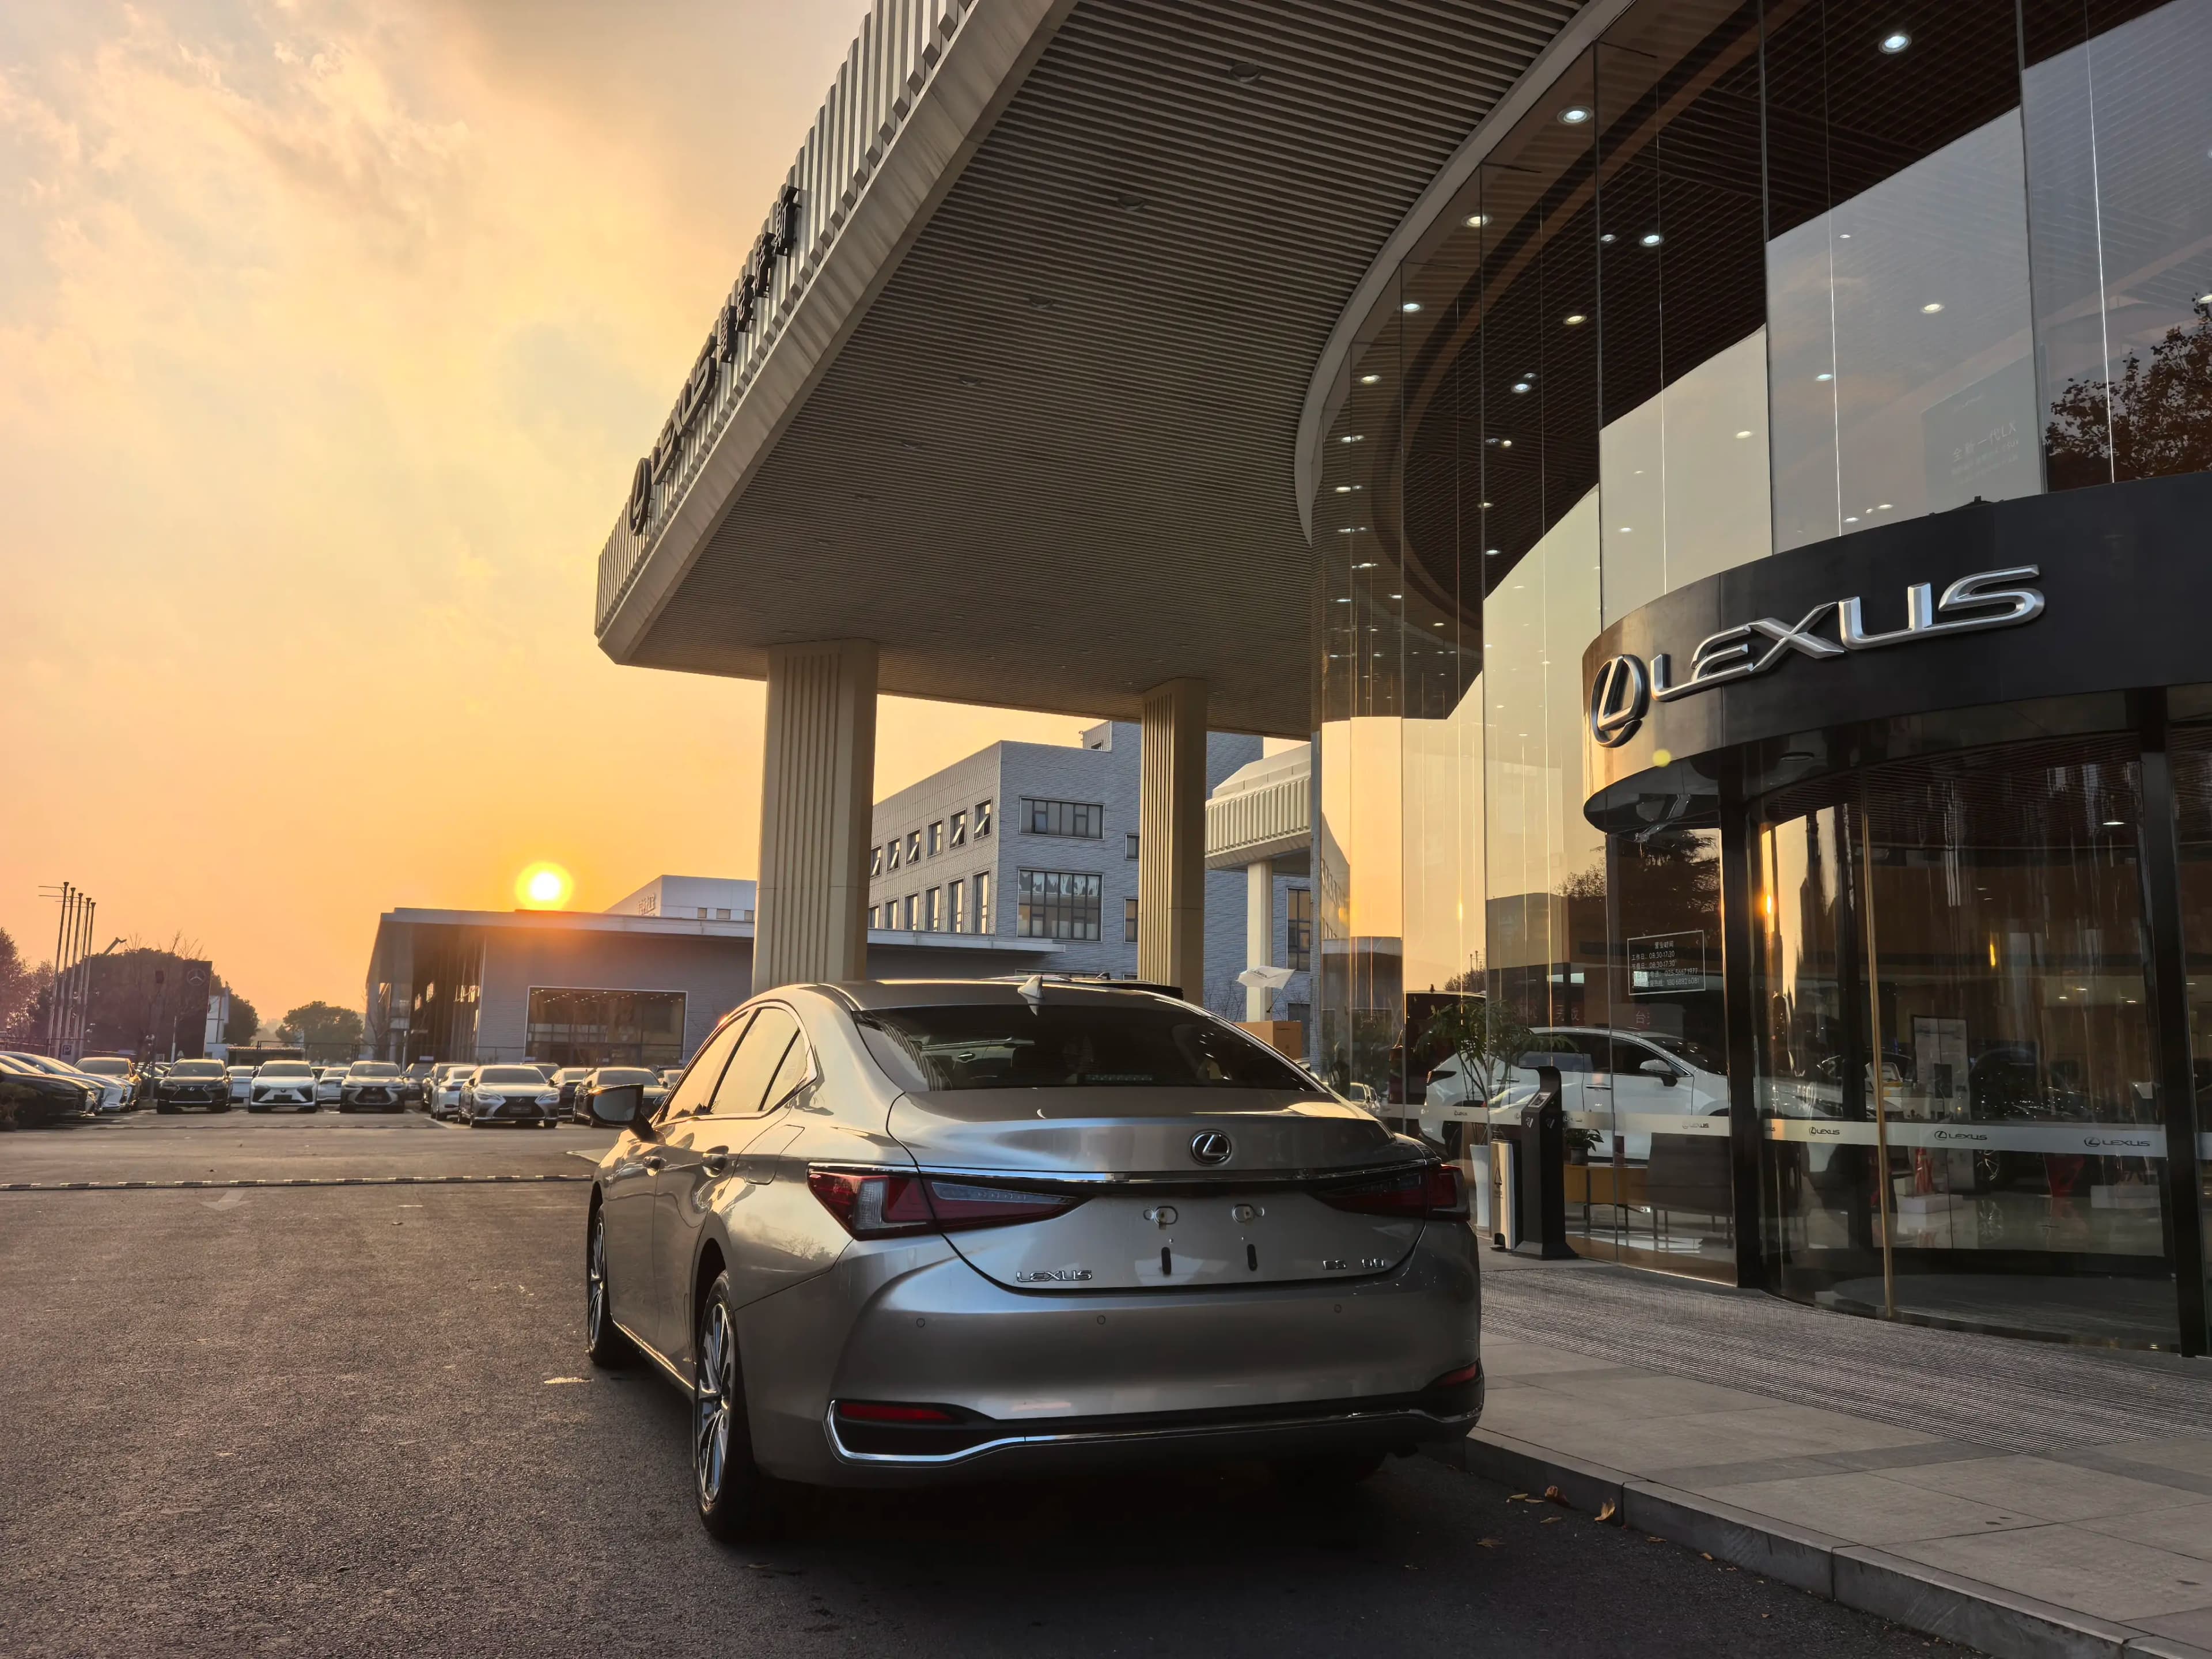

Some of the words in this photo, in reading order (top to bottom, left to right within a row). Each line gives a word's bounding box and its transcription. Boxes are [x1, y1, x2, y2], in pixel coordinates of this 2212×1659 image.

[652, 335, 718, 485] LEXUS
[1650, 564, 2046, 703] LEXUS
[1016, 1270, 1092, 1283] LEXUS
